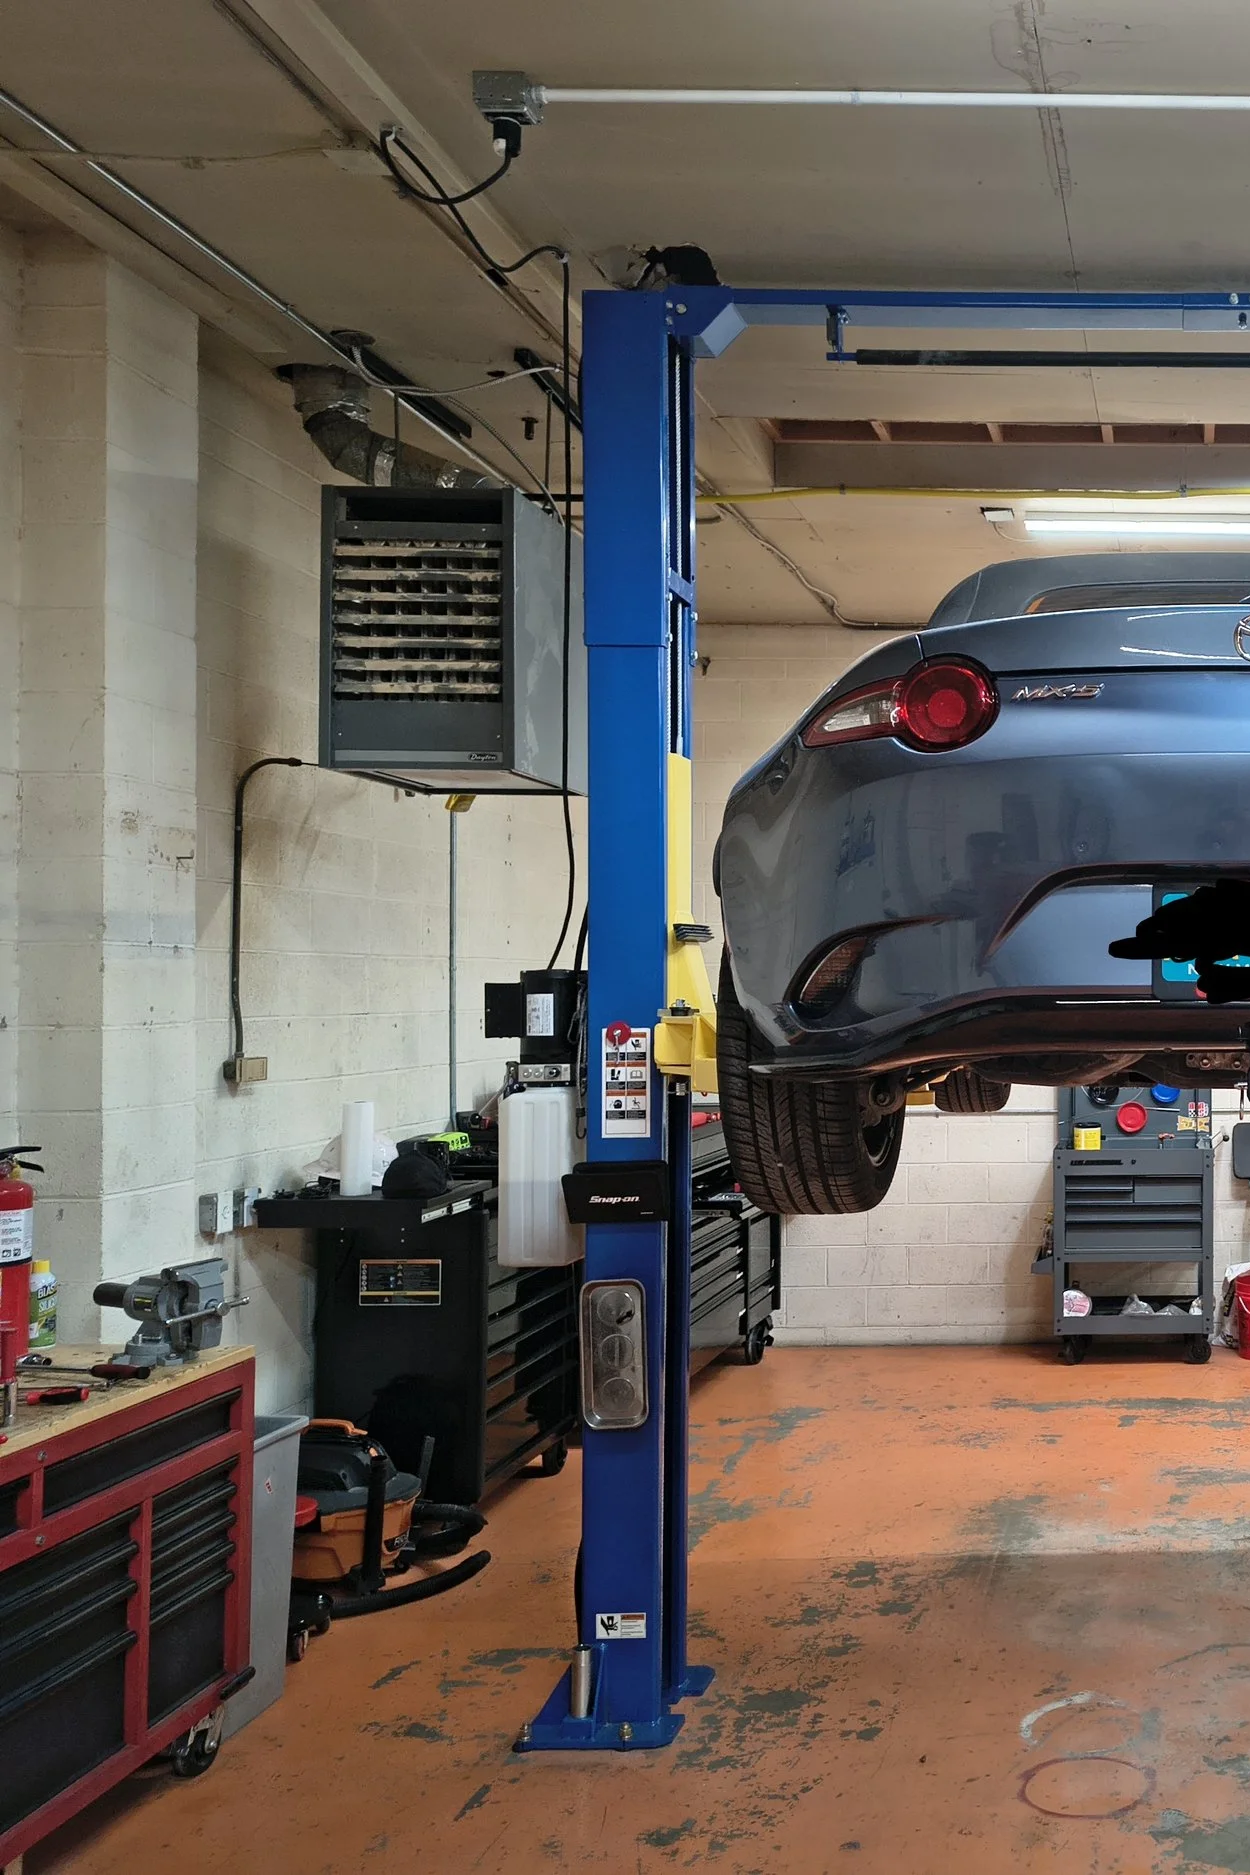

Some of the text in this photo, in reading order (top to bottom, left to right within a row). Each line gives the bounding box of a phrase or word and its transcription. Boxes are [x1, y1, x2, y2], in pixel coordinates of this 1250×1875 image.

[1011, 683, 1105, 702] MX-5
[470, 753, 497, 762] Dayton
[589, 1195, 641, 1205] Snap-on
